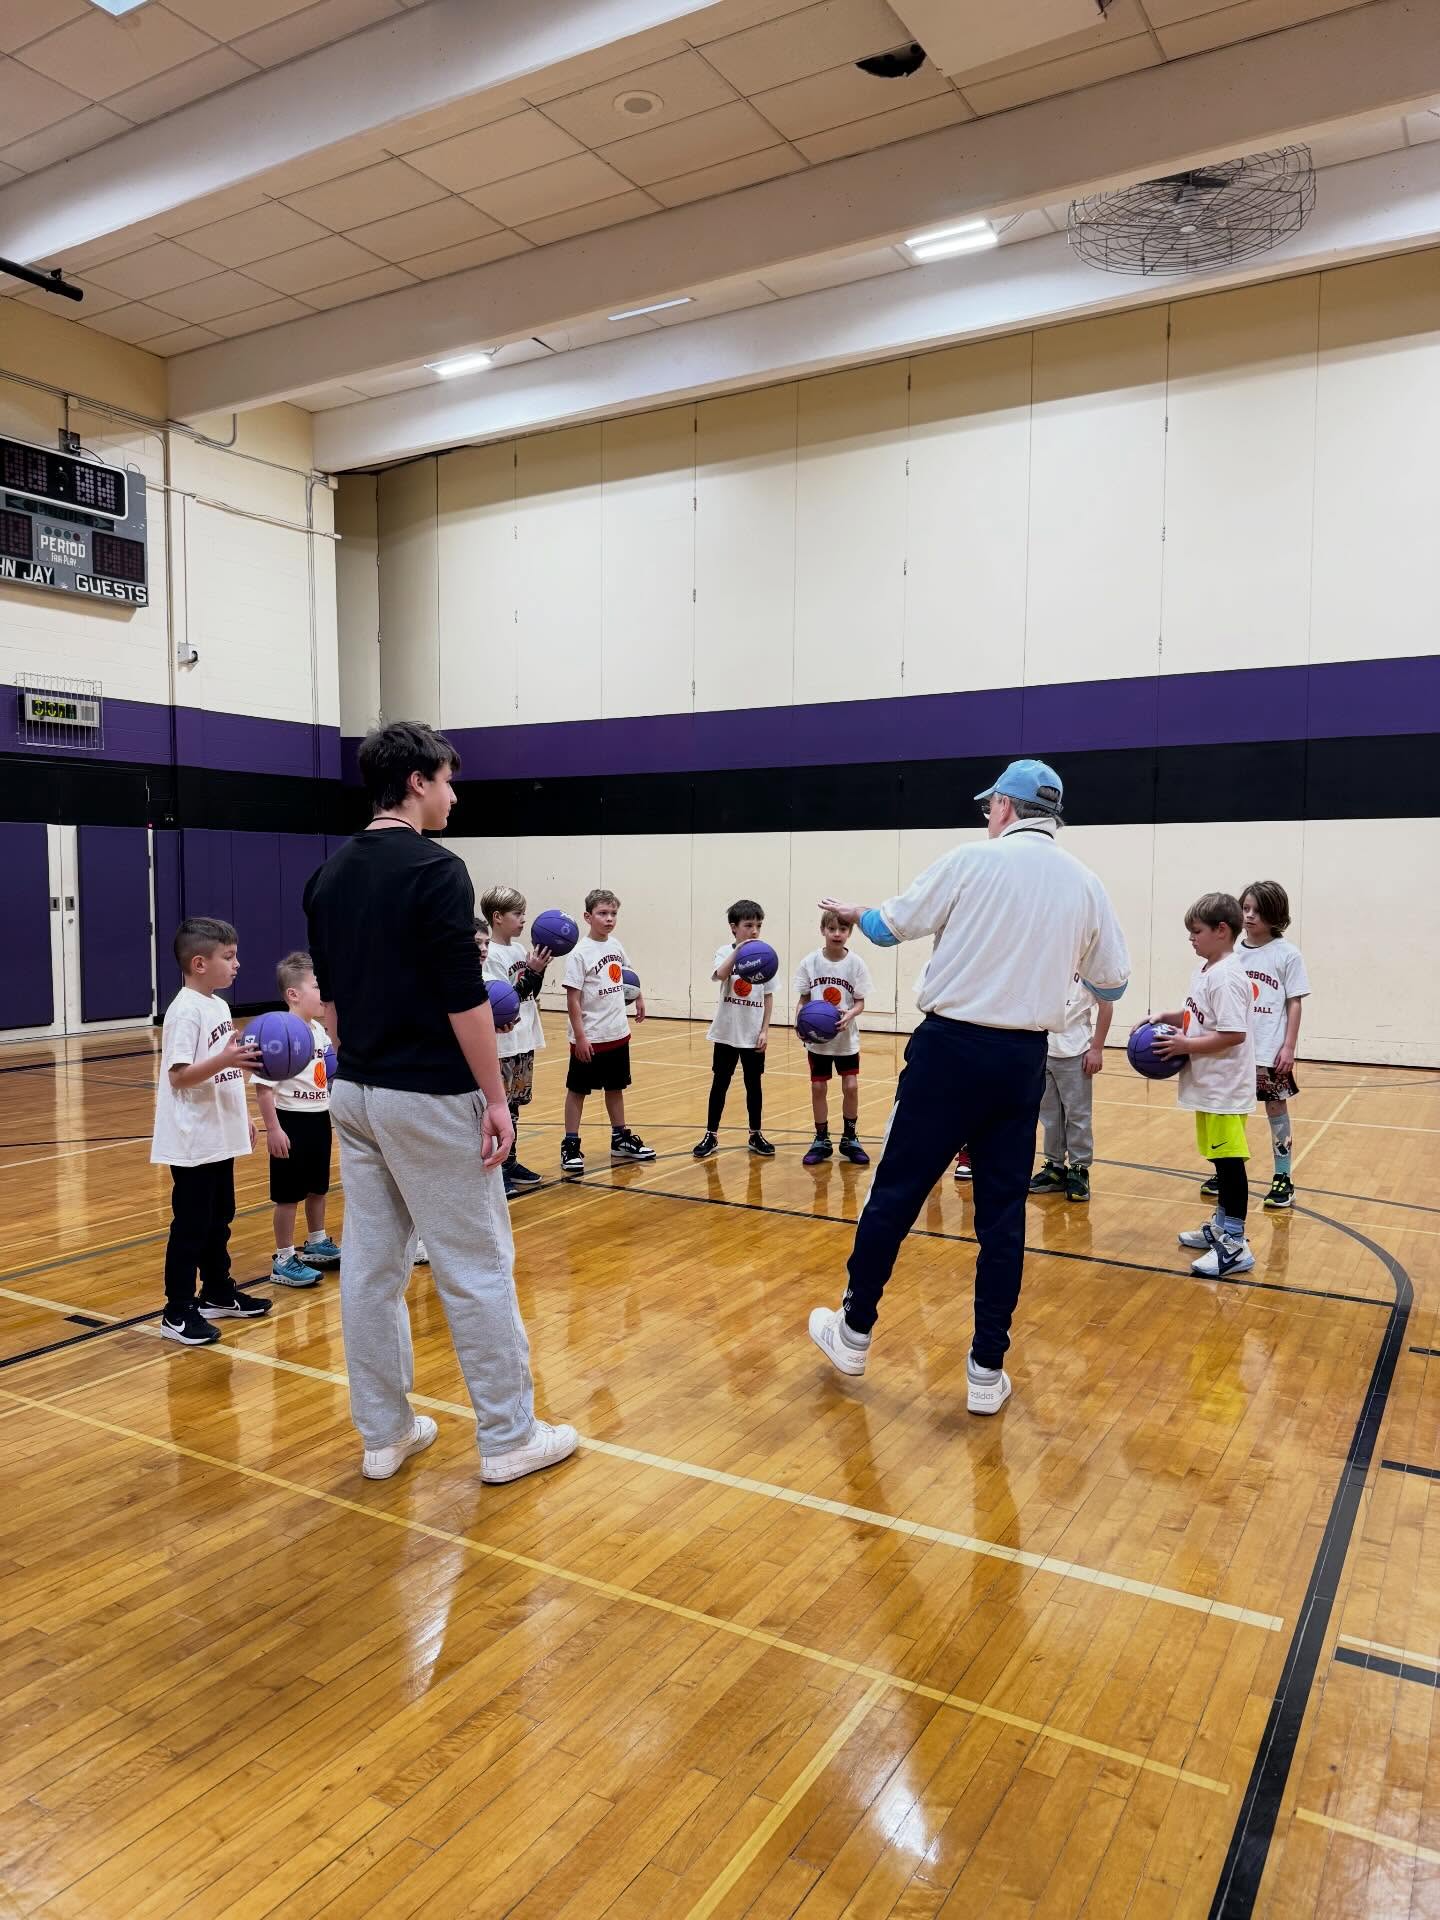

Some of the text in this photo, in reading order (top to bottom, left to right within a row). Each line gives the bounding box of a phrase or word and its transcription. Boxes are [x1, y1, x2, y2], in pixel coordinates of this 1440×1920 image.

[40, 534, 86, 558] PERIOD
[23, 563, 53, 585] JAY
[76, 574, 147, 603] GUESTS
